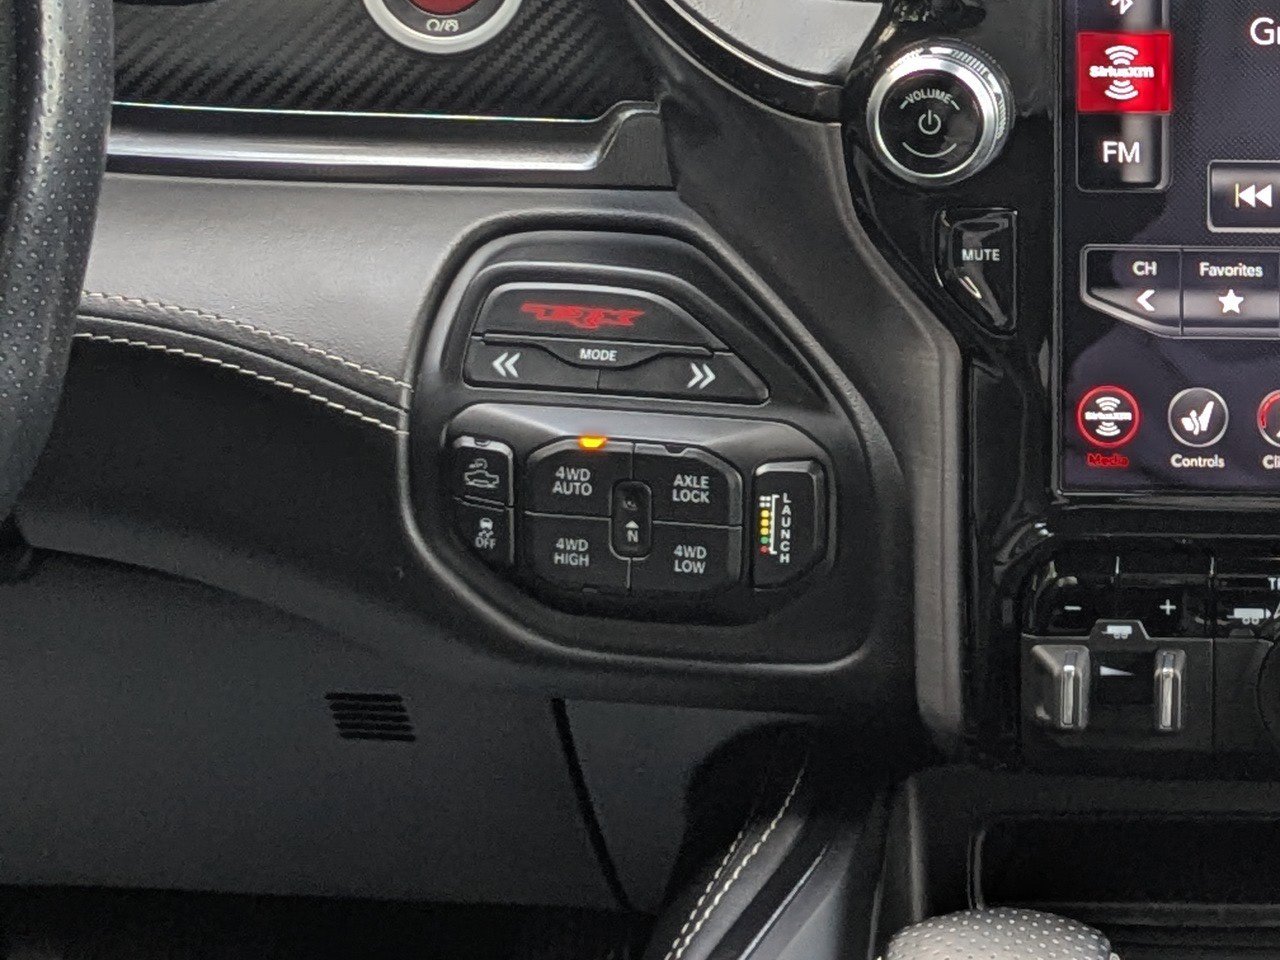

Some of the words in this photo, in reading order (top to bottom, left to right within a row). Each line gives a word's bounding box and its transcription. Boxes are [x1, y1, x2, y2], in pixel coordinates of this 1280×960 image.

[905, 89, 953, 105] VOLUME
[1102, 141, 1141, 163] FM
[962, 248, 1000, 262] MUTE
[1132, 260, 1157, 277] CH
[1199, 261, 1263, 278] Favorites
[579, 348, 617, 362] MODE
[1170, 453, 1225, 469] Controls
[555, 466, 591, 482] 4WD
[673, 473, 709, 489] AXLE
[552, 481, 592, 497] AUTO
[672, 489, 710, 505] LOCK
[626, 530, 639, 543] N
[778, 493, 791, 564] LAUNCH
[475, 536, 496, 550] OFF
[555, 538, 589, 552] 4WD
[554, 552, 590, 568] HIGH
[674, 545, 707, 560] 4WD
[674, 560, 706, 574] LOW
